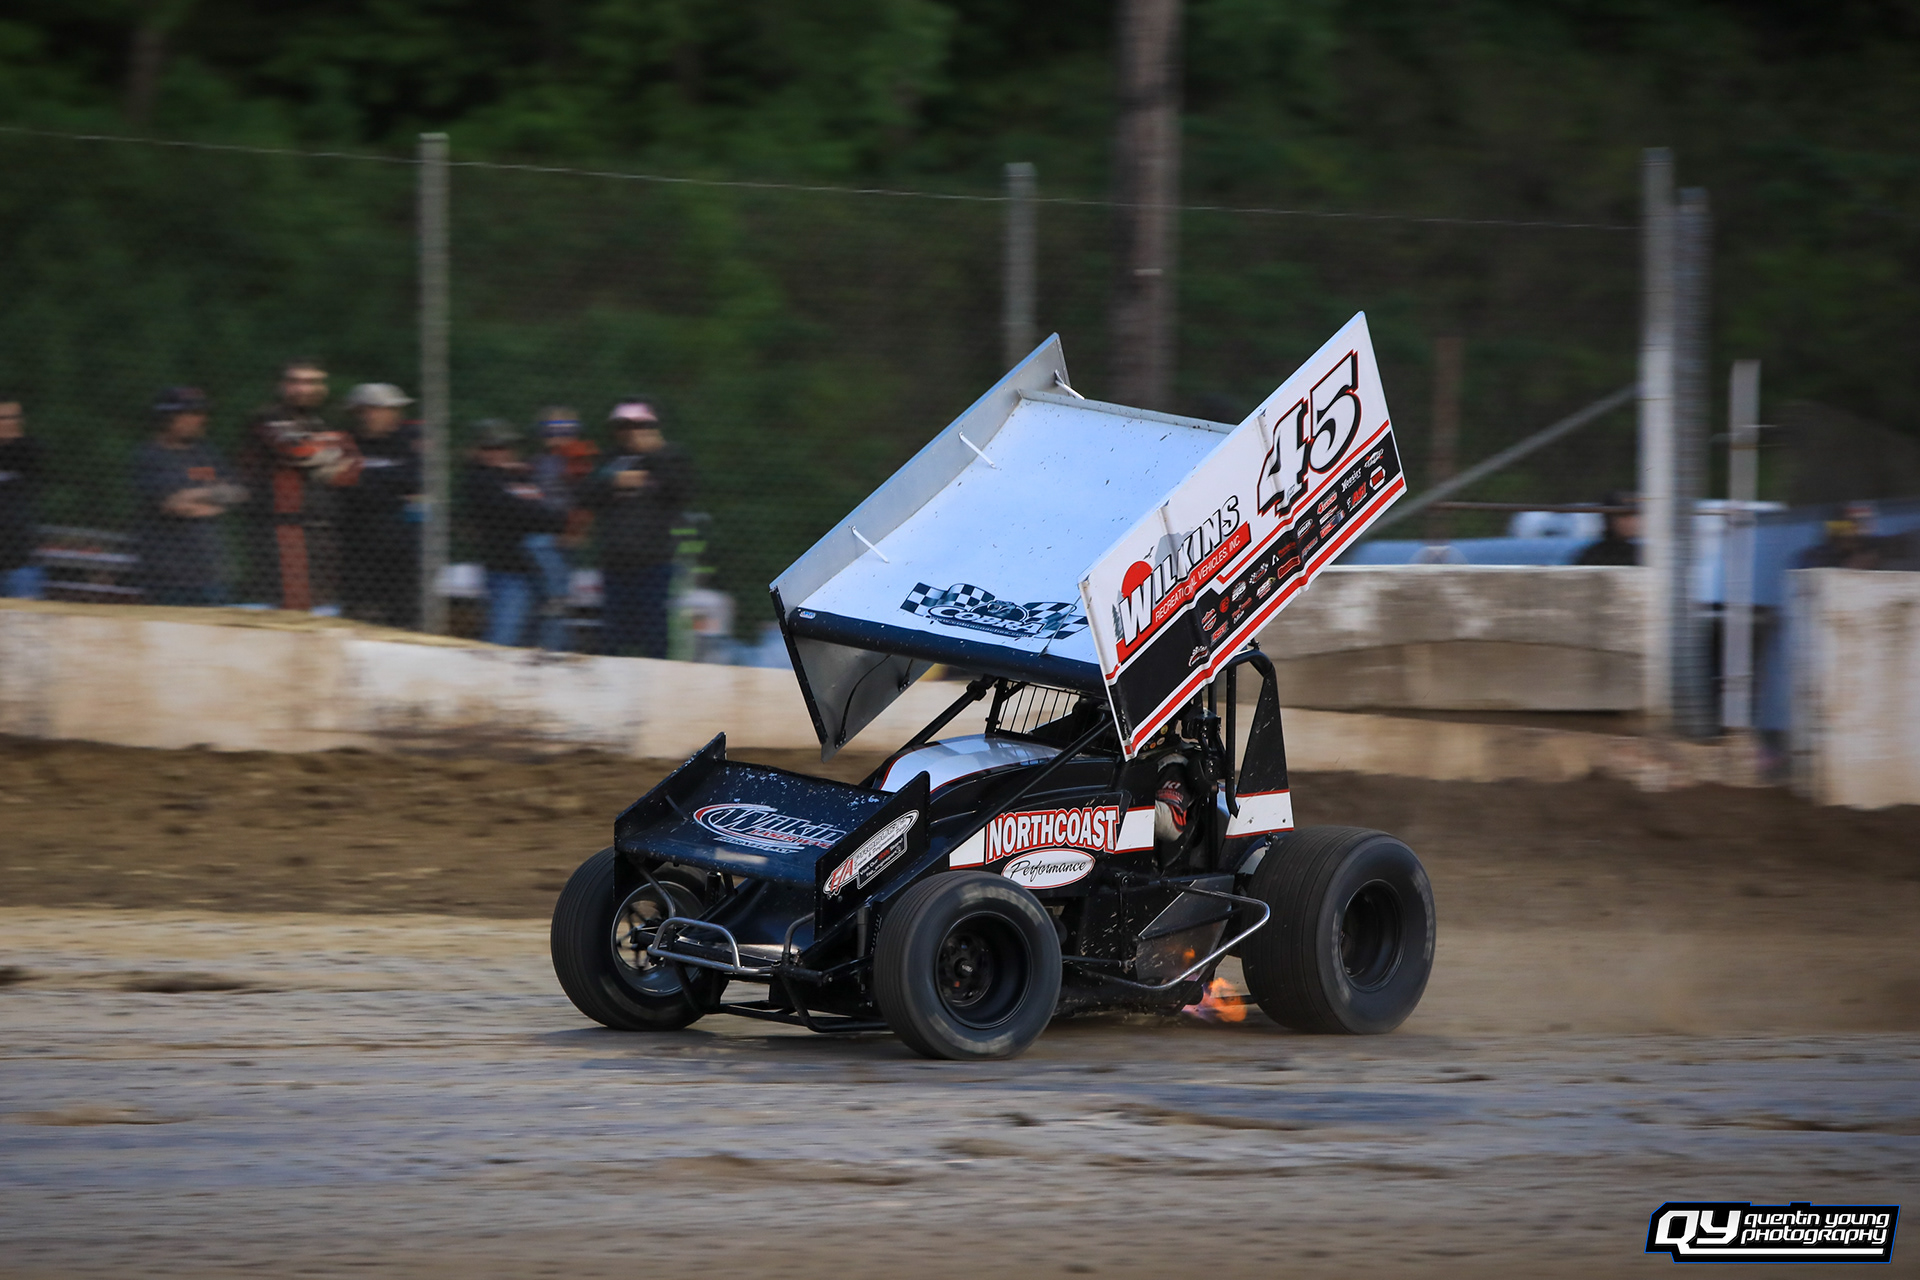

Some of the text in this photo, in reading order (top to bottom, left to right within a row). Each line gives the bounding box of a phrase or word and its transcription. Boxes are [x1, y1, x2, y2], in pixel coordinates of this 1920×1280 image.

[1257, 349, 1361, 517] 45
[1119, 495, 1240, 647] WILKINS
[928, 606, 1046, 634] COBRA
[1155, 577, 1198, 623] RECREATIONAL
[986, 807, 1119, 863] NORTHCOAST
[1010, 860, 1087, 883] Performance
